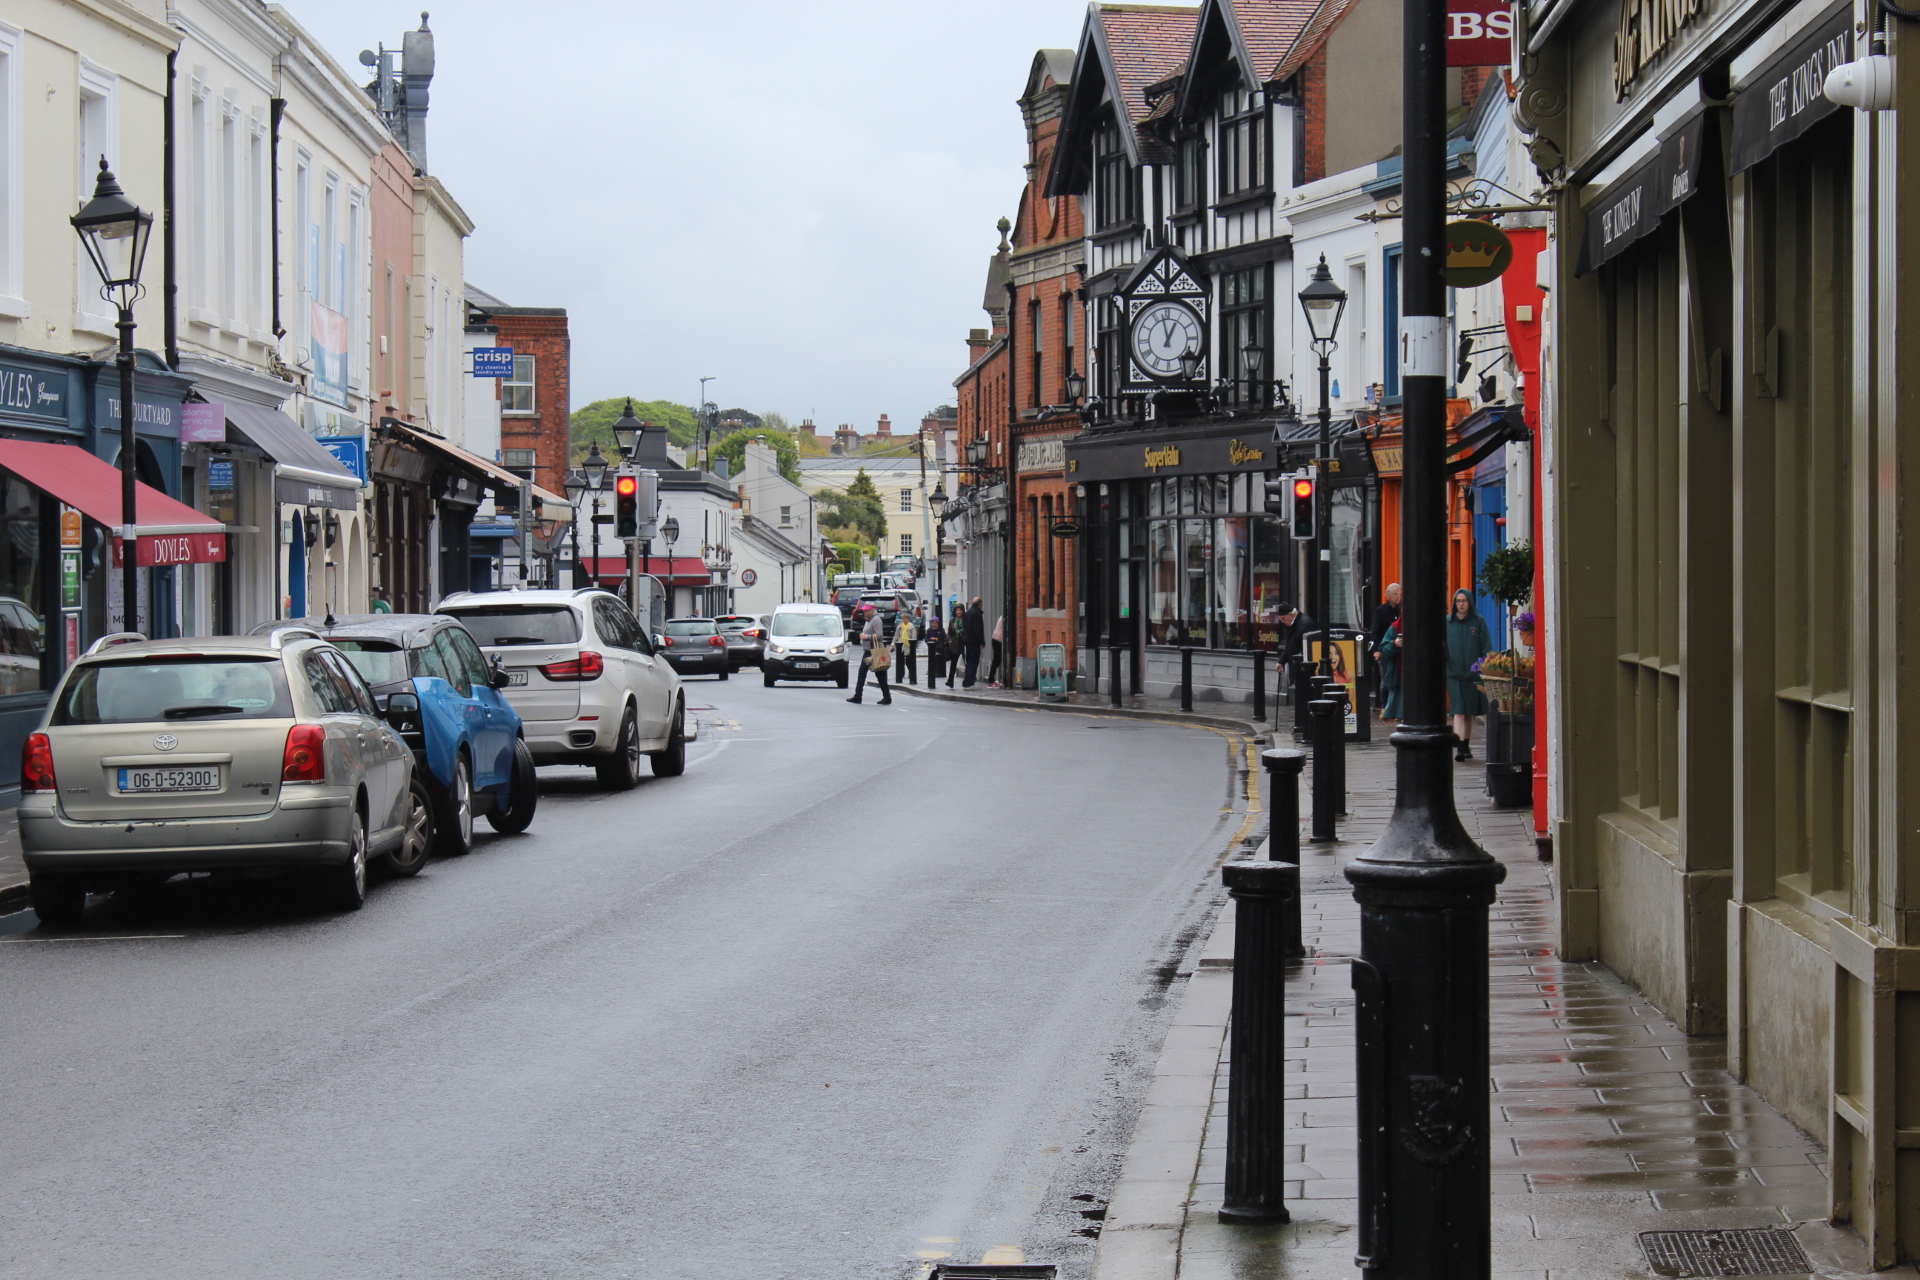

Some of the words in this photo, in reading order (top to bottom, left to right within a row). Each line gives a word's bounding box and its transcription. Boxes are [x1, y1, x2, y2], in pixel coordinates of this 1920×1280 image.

[1448, 11, 1512, 40] BS
[1769, 76, 1788, 132] THE
[1791, 48, 1823, 117] KINGS
[475, 350, 511, 364] crisp
[108, 398, 121, 418] TH
[134, 402, 171, 425] OURTYARD
[182, 408, 212, 417] ailoring
[1144, 445, 1180, 473] SuperValu
[154, 538, 191, 562] DOYLES
[134, 771, 211, 788] 06-D-52300
